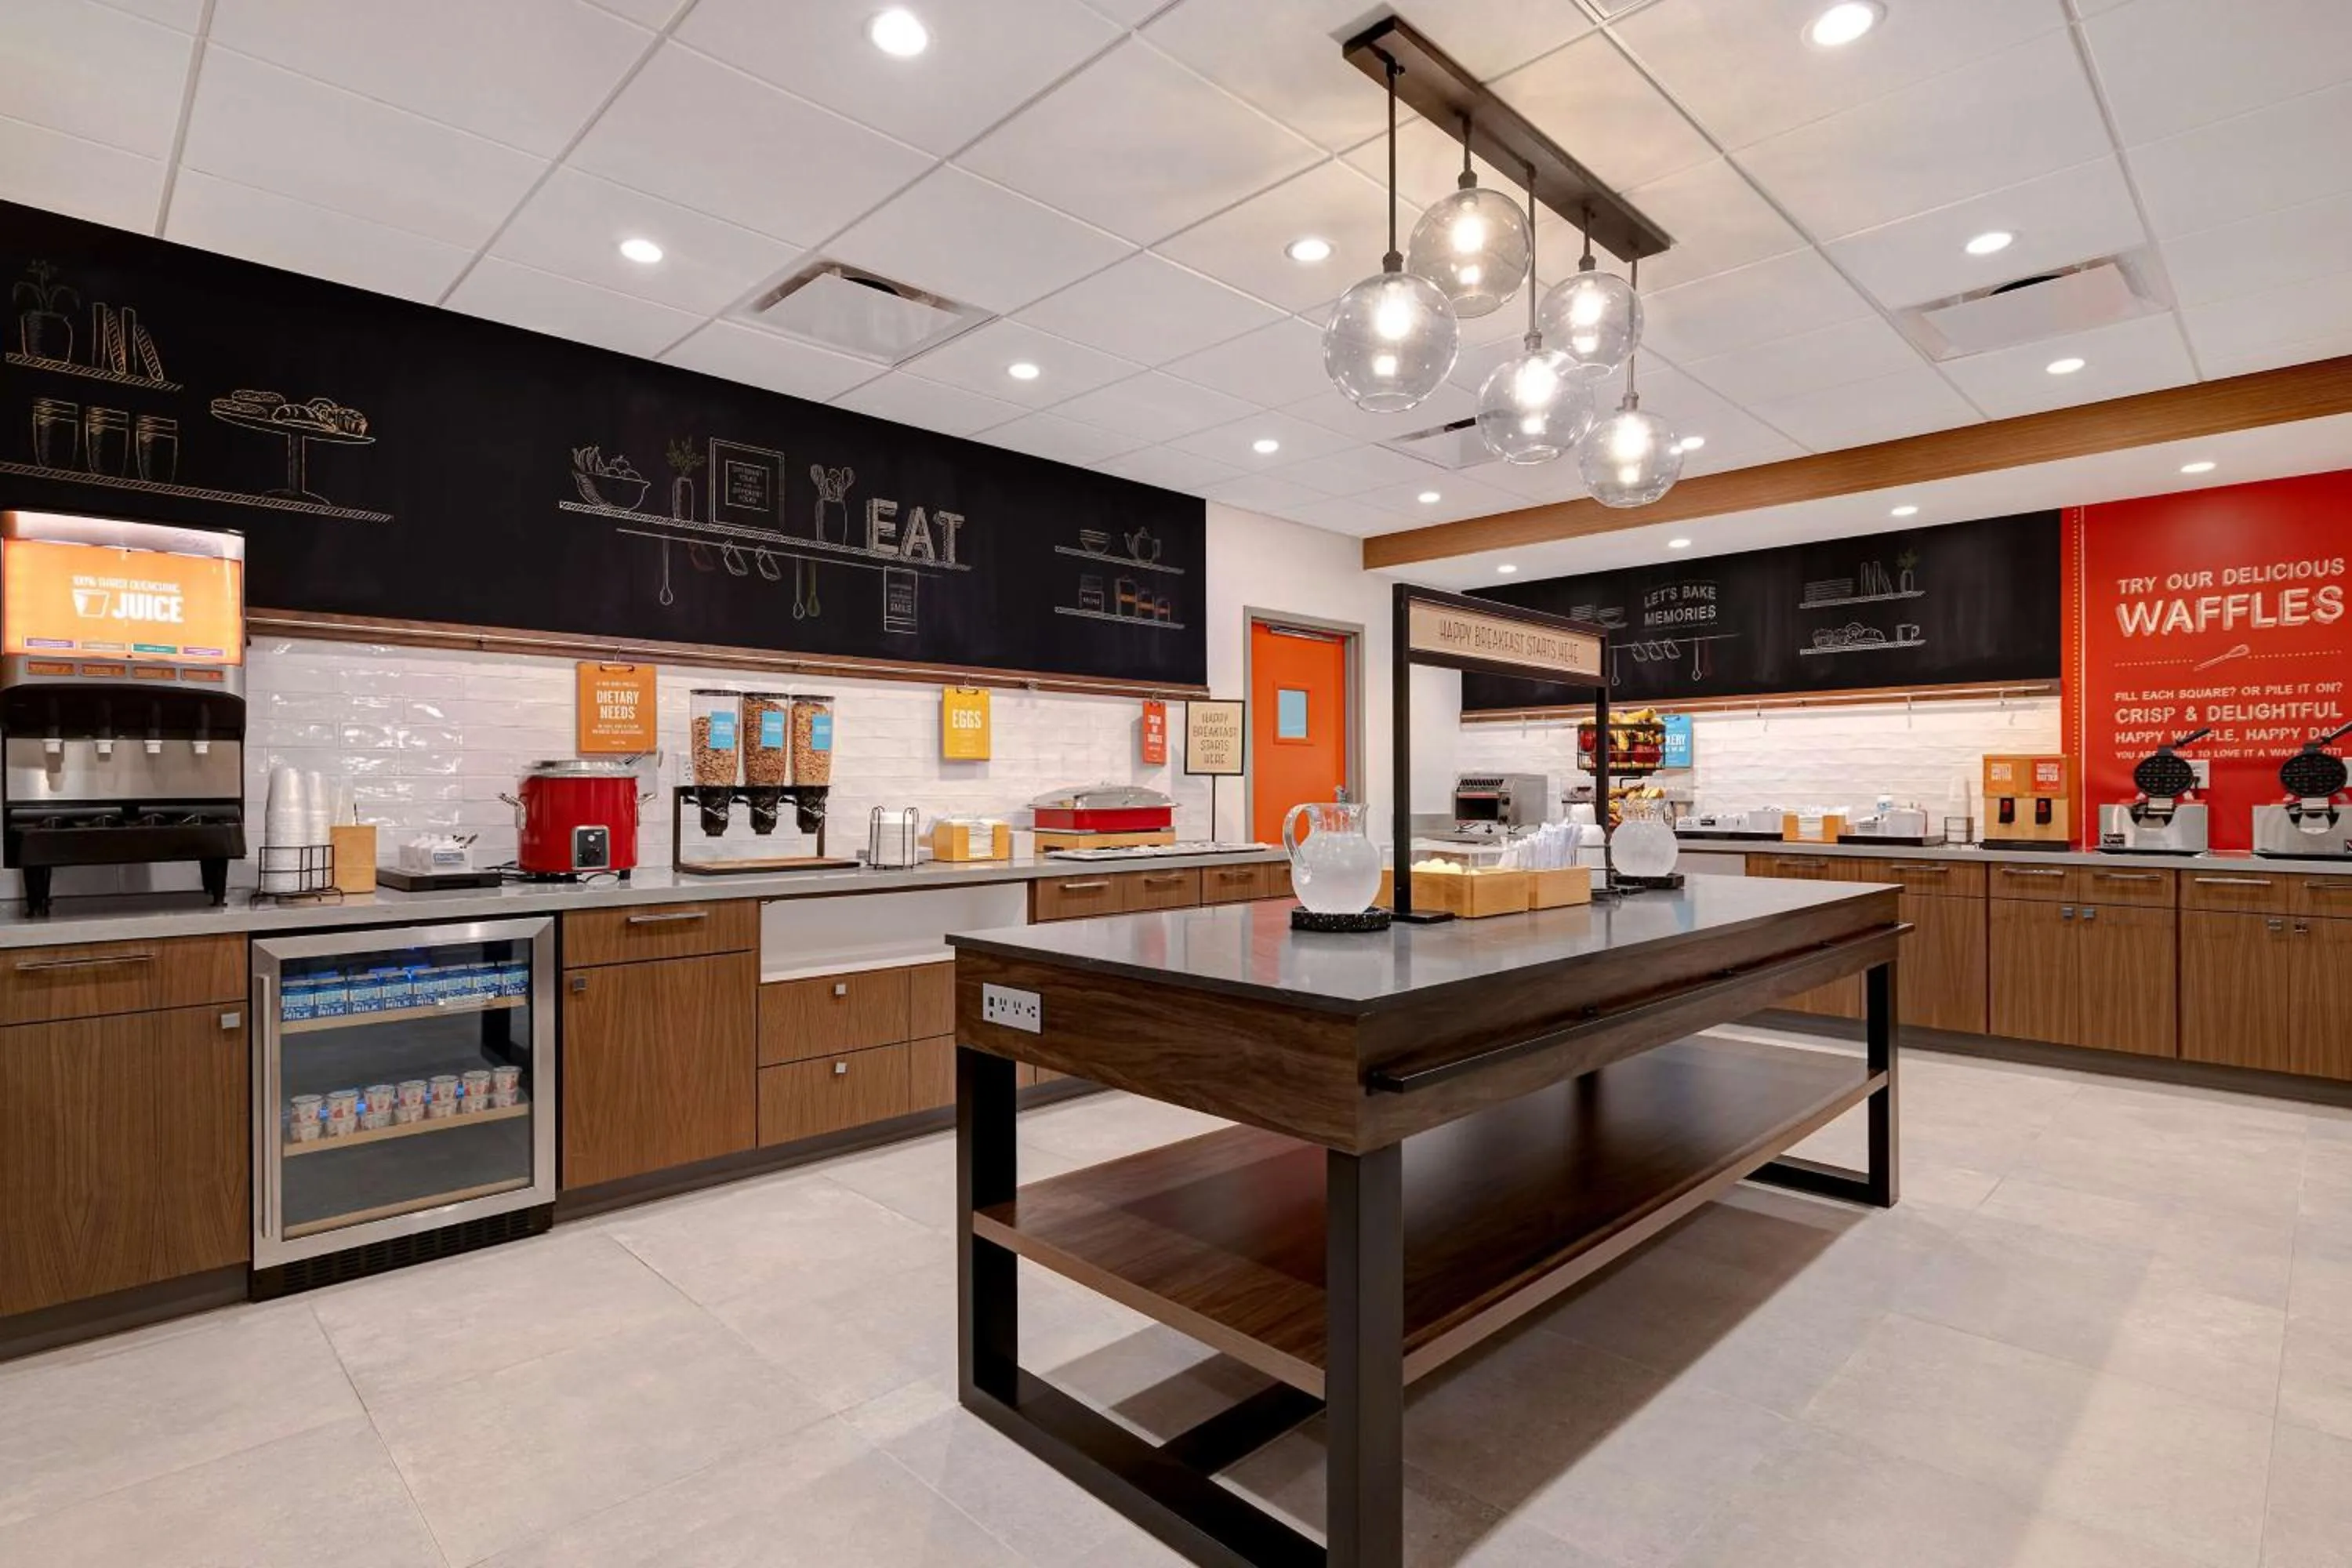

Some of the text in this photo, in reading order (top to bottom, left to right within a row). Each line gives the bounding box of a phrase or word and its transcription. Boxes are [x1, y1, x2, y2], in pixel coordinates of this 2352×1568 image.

[866, 498, 965, 563] EAT
[2118, 557, 2345, 595] TRY OUR DELICIOUS
[111, 592, 184, 622] JUICE
[1644, 586, 1717, 608] LET'S BAKE
[1644, 604, 1717, 626] MEMORIES
[2116, 585, 2345, 637] WAFFLES
[1441, 619, 1579, 665] HAPPY BREAKFAST STARTS HERE
[597, 689, 640, 705] DIETARY
[2114, 681, 2343, 702] FILL EACH SQUARE? OR PILE IT ON?
[599, 704, 637, 720] NEEDS
[952, 708, 982, 729] EGGS
[1201, 710, 1229, 725] HAPPY
[2114, 700, 2344, 724] CRISP & DELIGHTFUL
[1192, 725, 1239, 739] BREAKFAST
[2114, 731, 2165, 744] HAPPY
[2245, 727, 2302, 741] HAPPY
[1200, 739, 1230, 752] STARTS
[2115, 750, 2136, 760] YOU
[2213, 748, 2241, 758] LOVE
[2257, 748, 2266, 757] A
